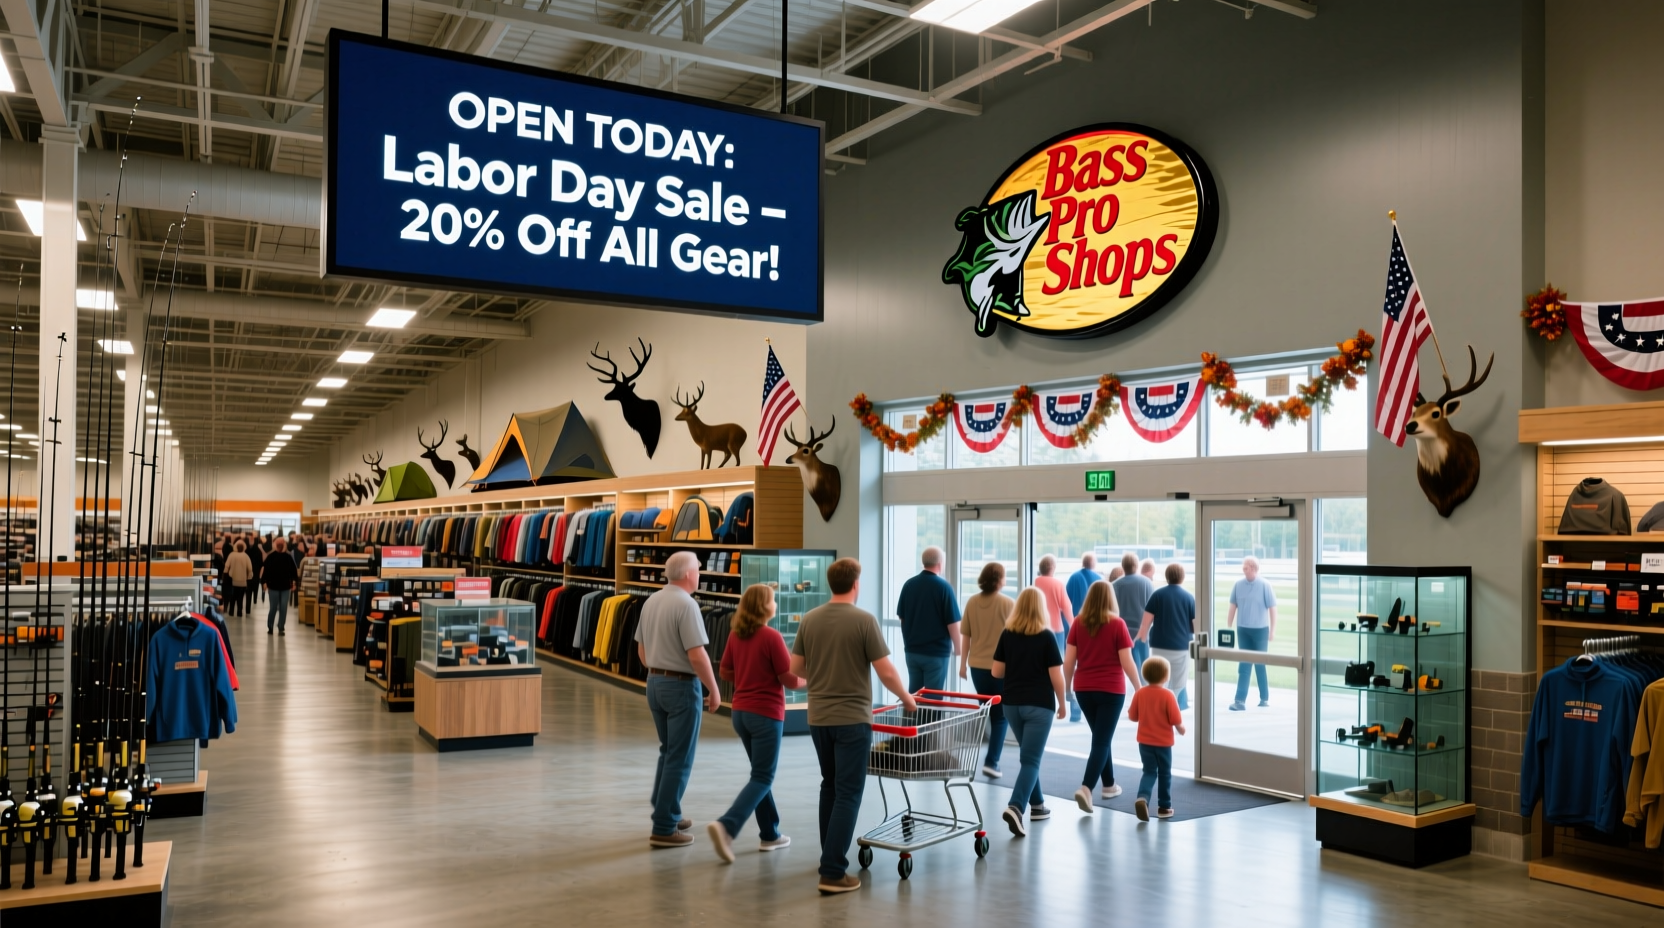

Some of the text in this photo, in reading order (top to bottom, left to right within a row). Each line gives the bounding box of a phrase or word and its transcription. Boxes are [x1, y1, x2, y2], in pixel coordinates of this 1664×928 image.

[448, 91, 735, 169] OPEN TODAY:
[383, 134, 538, 198] Labor
[550, 159, 646, 222] Day
[654, 175, 750, 226] Sale
[1041, 140, 1149, 200] Bass
[400, 198, 779, 281] 20% Off All Gear!
[1044, 194, 1120, 245] Pro
[1042, 233, 1178, 298] Shops
